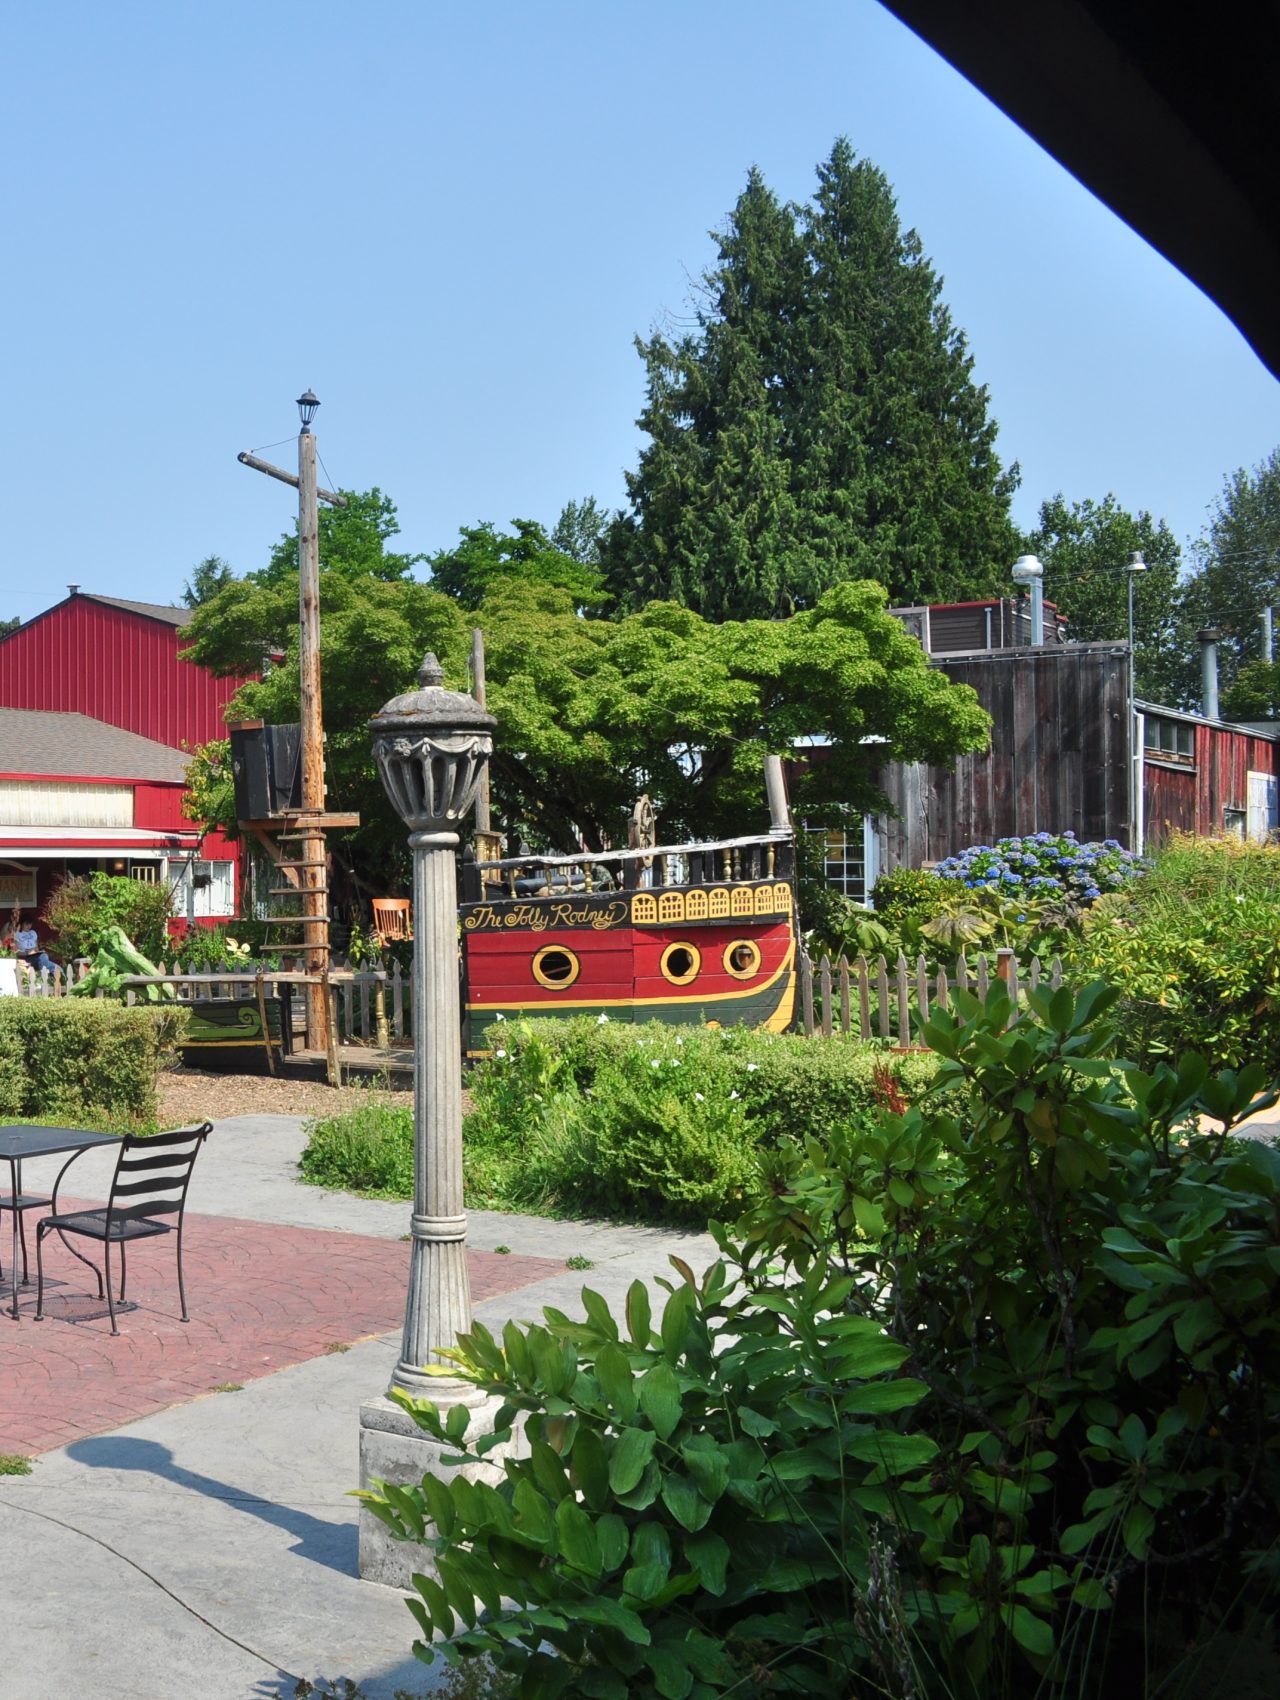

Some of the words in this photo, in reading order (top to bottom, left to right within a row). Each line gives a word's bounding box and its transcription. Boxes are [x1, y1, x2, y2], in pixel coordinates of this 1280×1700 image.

[465, 906, 503, 929] The
[504, 905, 549, 932] Jolly
[551, 901, 628, 930] Rodney
